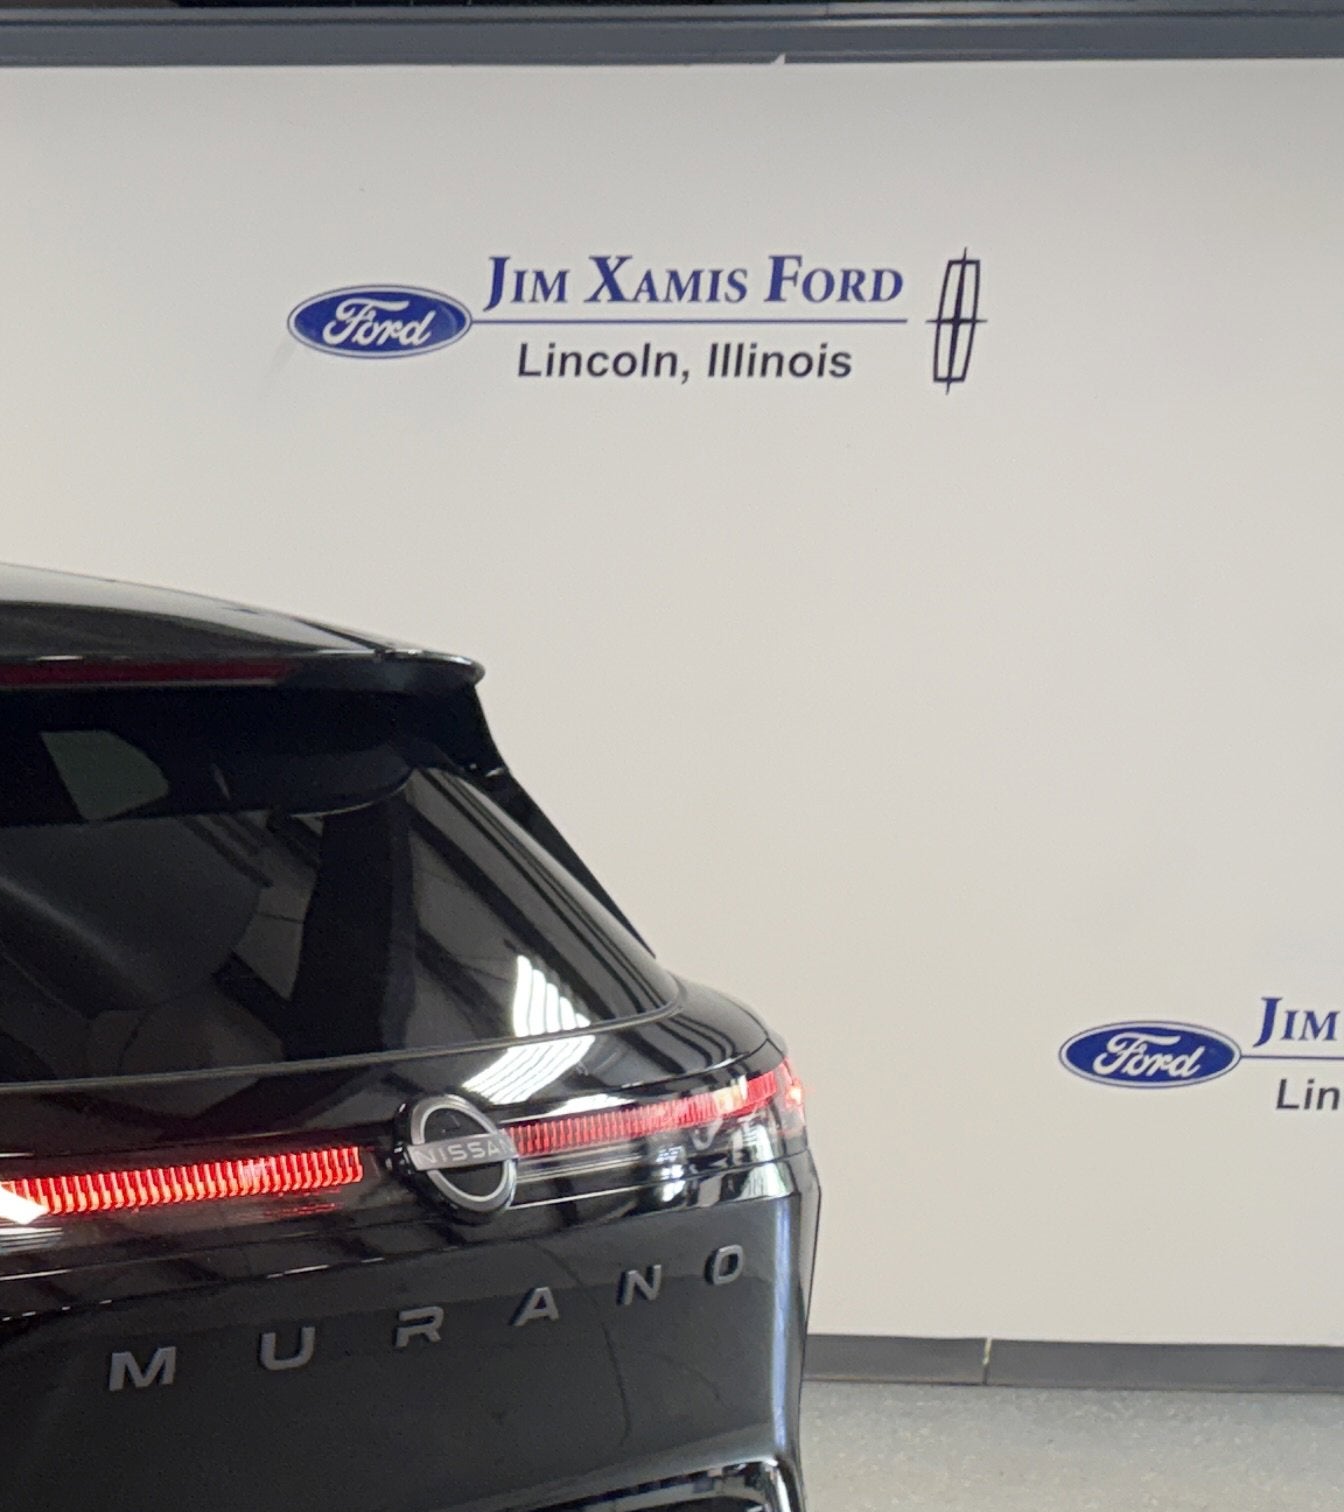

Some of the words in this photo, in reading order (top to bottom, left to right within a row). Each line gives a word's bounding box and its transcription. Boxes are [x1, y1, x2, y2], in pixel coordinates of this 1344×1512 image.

[321, 298, 433, 347] Ford
[517, 343, 690, 384] Lincoln,
[708, 343, 852, 378] Illinois
[1091, 1031, 1206, 1079] Ford
[414, 1138, 514, 1165] NISSAN
[108, 1244, 746, 1391] MURANO
